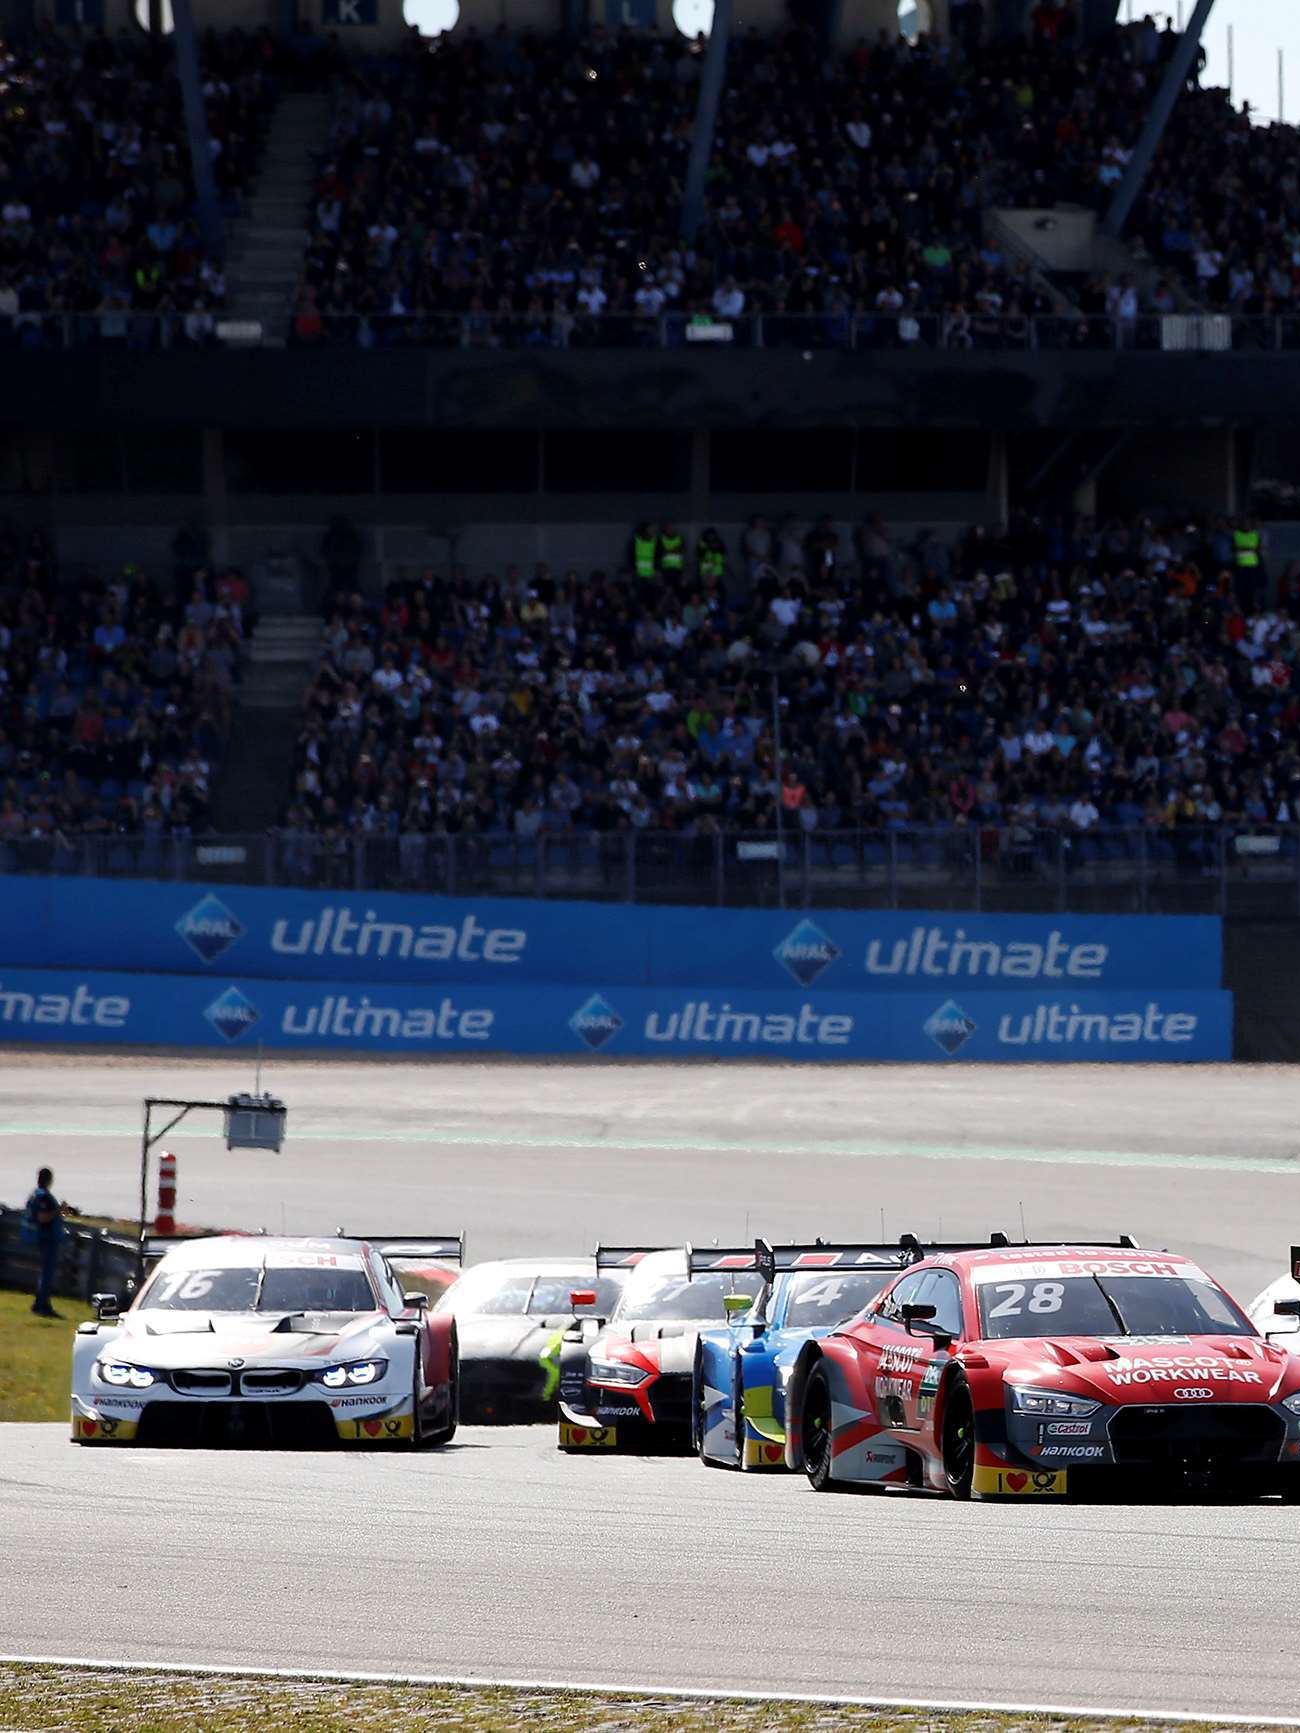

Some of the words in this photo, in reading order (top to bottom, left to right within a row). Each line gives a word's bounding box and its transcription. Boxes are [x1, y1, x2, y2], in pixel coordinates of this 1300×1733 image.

[339, 0, 362, 22] K
[271, 908, 527, 963] ultimate
[866, 927, 1109, 978] ultimate
[282, 996, 494, 1040] ultimate
[645, 1002, 853, 1045] ultimate
[998, 1003, 1198, 1044] ultimate
[159, 1271, 224, 1302] 16
[1057, 1262, 1179, 1276] BOSCH
[795, 1278, 843, 1306] 4
[989, 1283, 1064, 1318] 28
[1107, 1367, 1264, 1387] WORKWEAR
